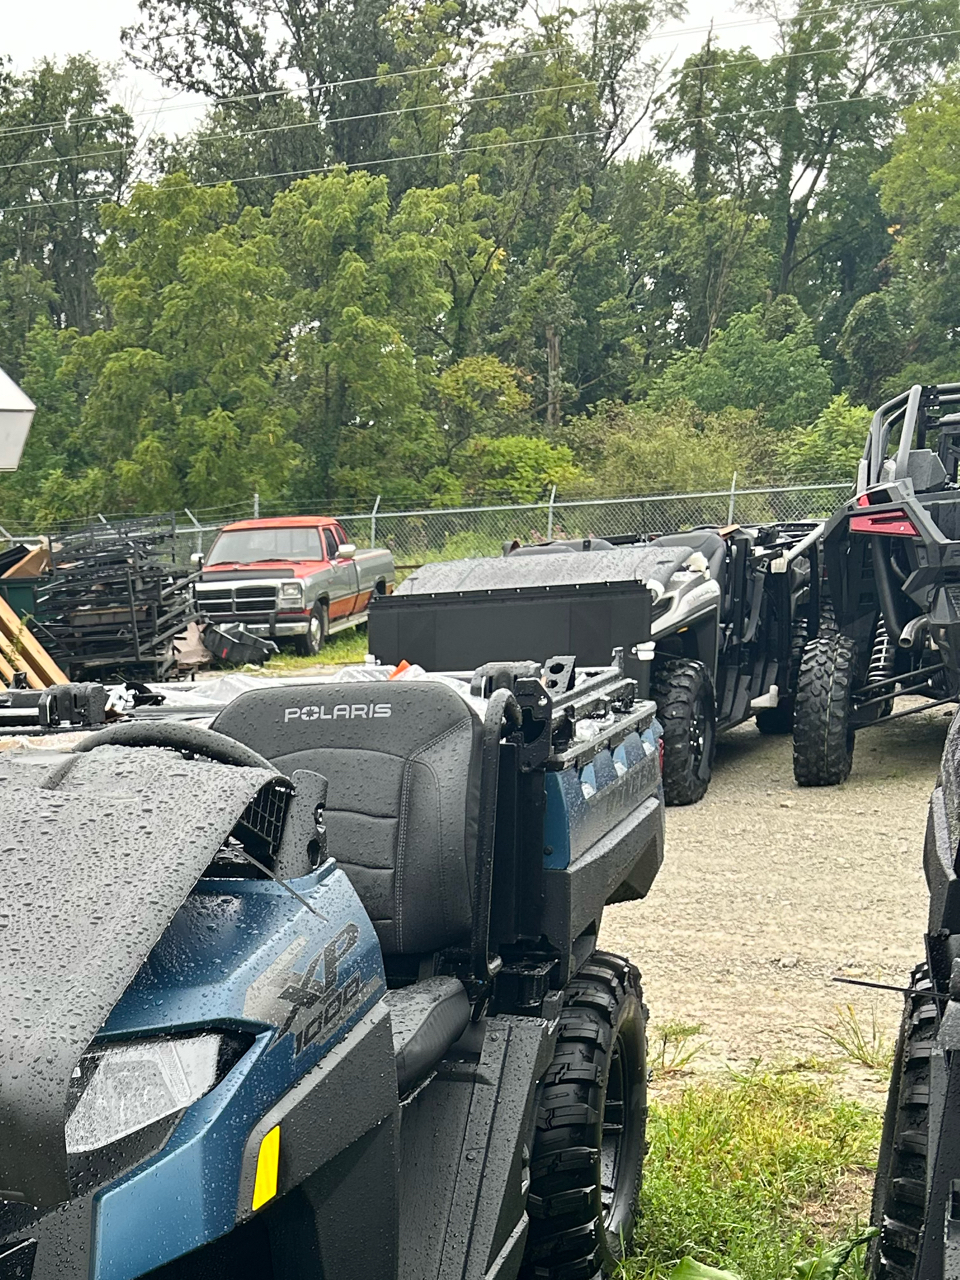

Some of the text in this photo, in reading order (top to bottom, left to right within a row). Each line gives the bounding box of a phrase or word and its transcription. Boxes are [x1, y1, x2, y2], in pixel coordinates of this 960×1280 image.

[284, 703, 392, 722] POLARIS
[273, 921, 359, 1043] XP
[294, 971, 362, 1057] 1000
